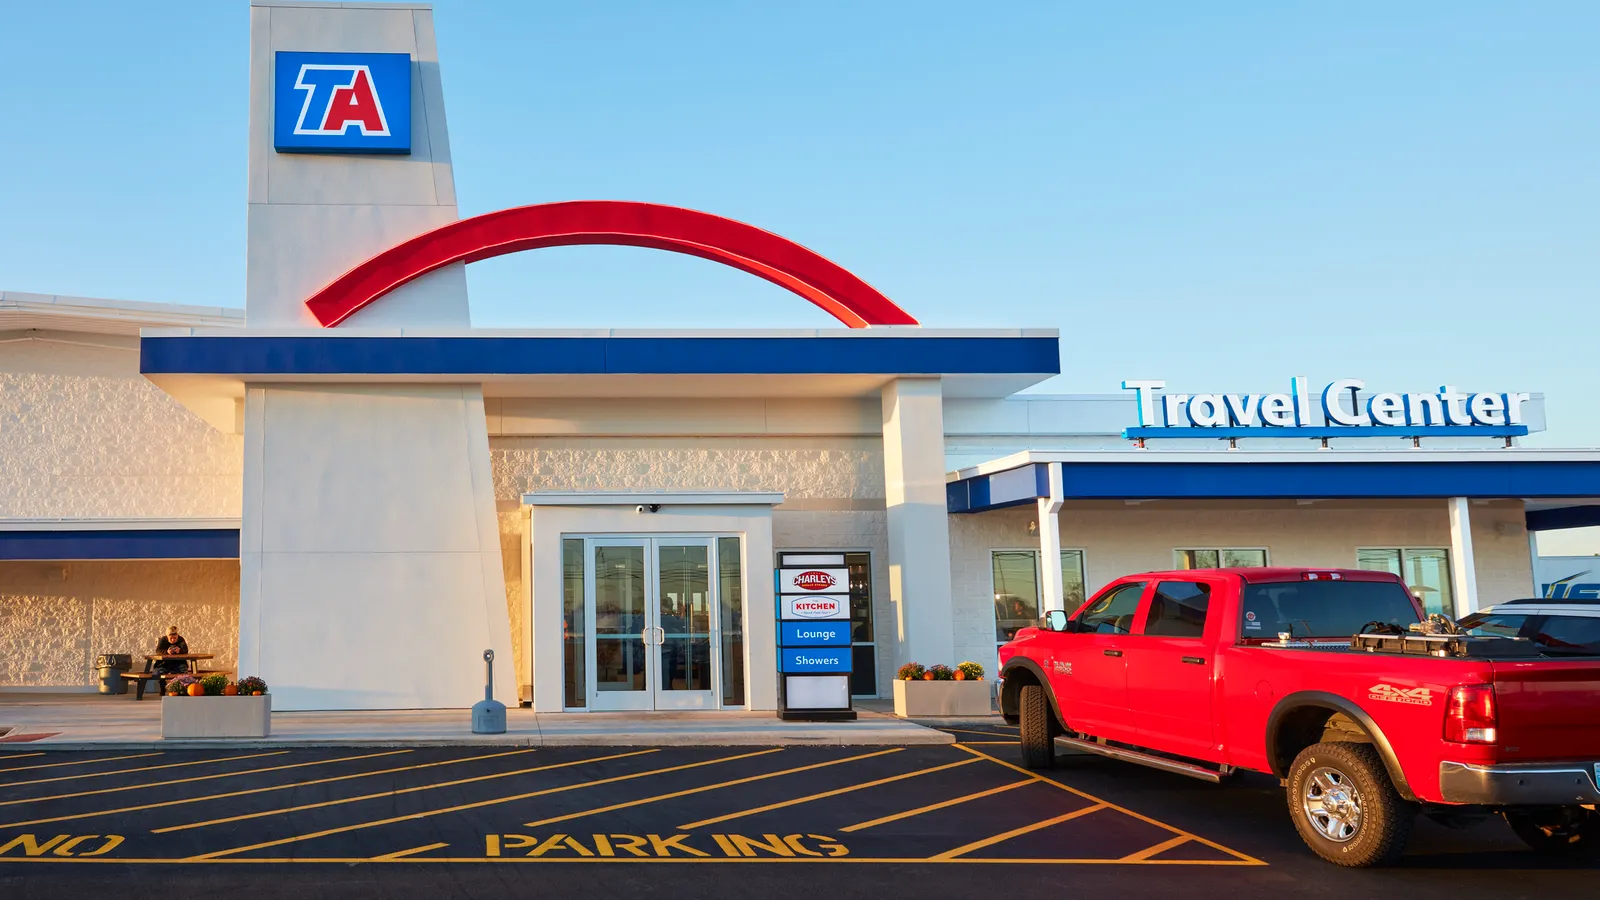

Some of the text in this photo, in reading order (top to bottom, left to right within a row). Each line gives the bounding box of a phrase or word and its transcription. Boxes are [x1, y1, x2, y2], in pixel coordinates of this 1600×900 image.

[293, 64, 391, 136] TA
[1121, 376, 1530, 428] Travel Center
[792, 574, 837, 586] CHARLEYS
[797, 629, 836, 641] Lounge
[795, 656, 839, 665] Showers
[1368, 683, 1433, 700] 4x4
[0, 833, 850, 857] NO PARKING
